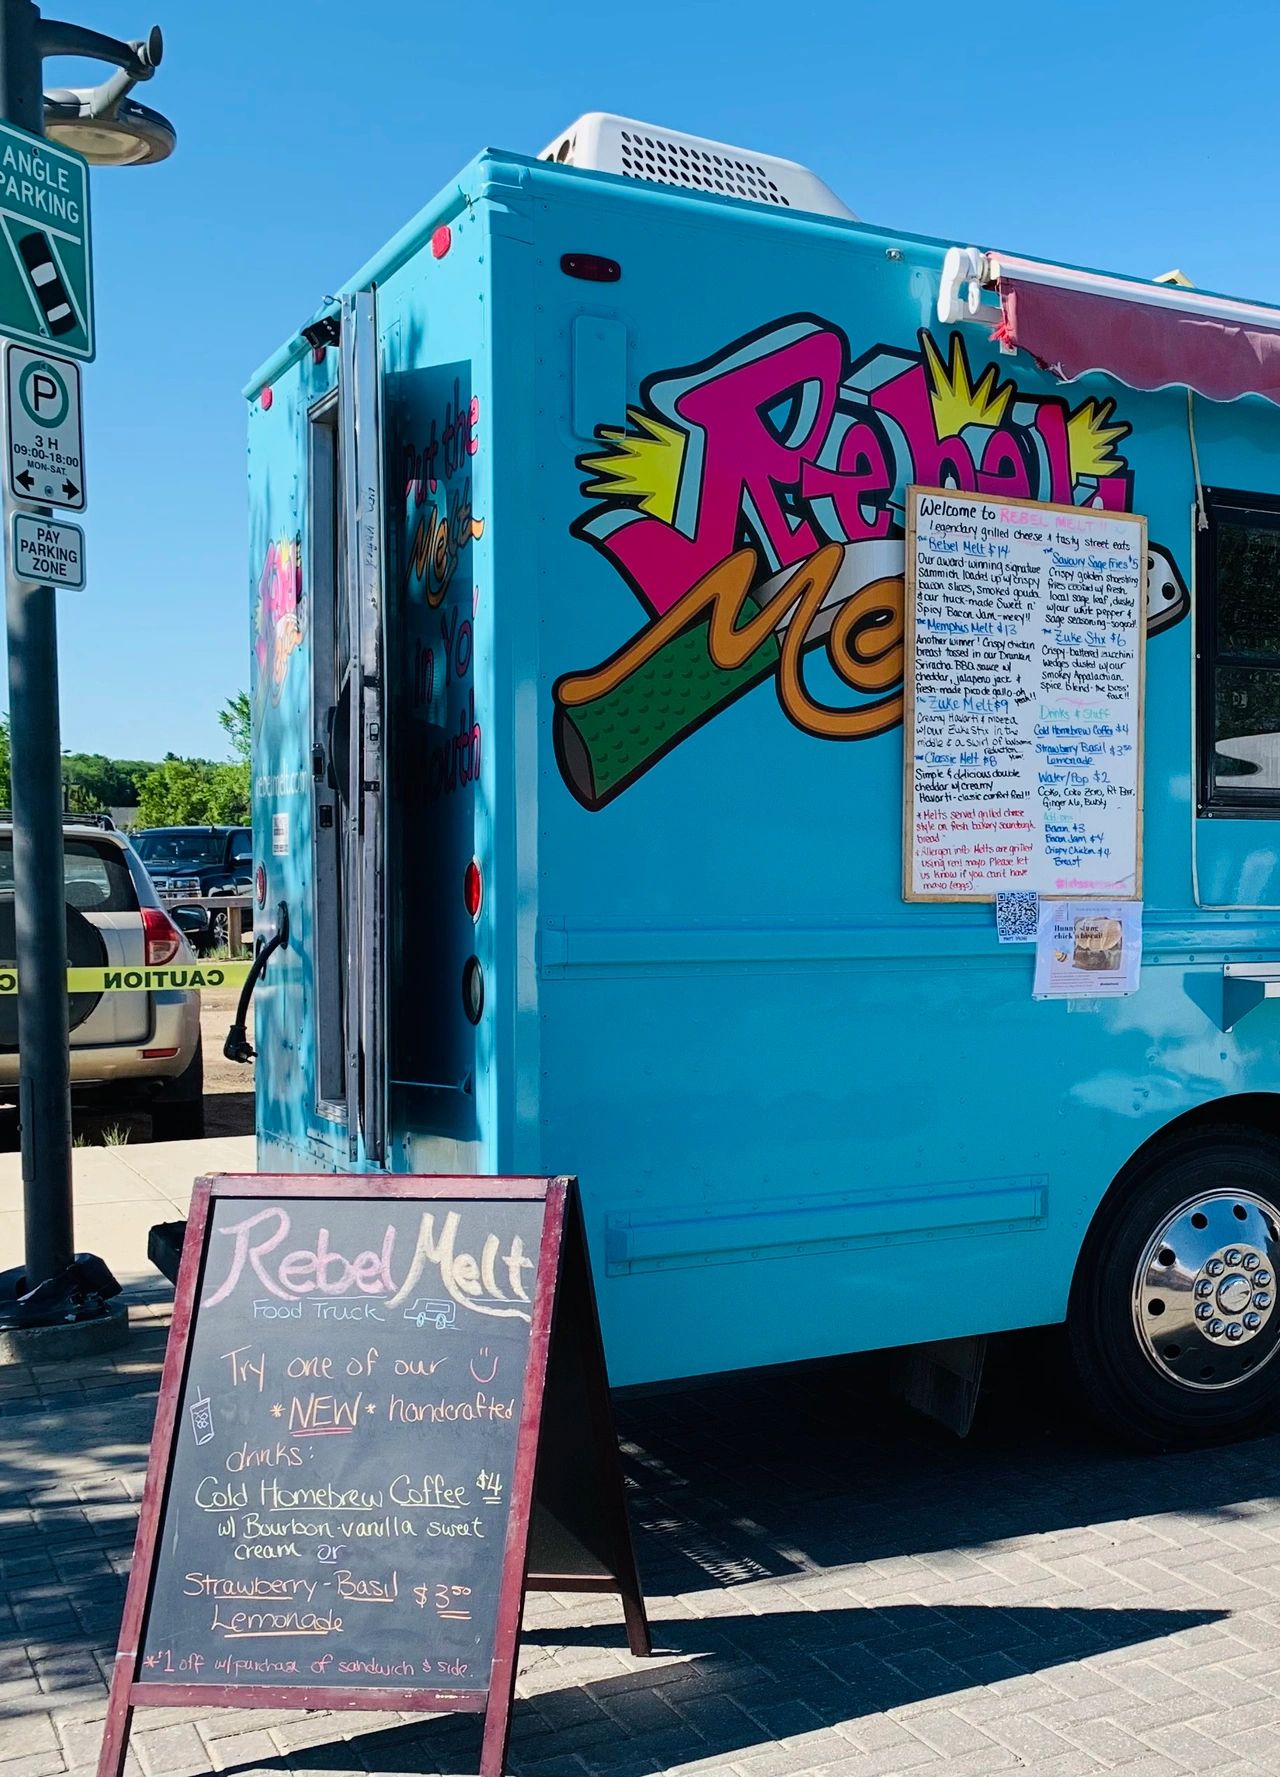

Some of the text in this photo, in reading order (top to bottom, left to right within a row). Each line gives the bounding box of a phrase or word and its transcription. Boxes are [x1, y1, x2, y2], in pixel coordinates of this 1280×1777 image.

[2, 145, 70, 193] ANGLE
[33, 374, 57, 412] P
[442, 376, 479, 479] the
[35, 435, 58, 450] 3 H
[14, 443, 79, 467] 09:00-18:00
[920, 498, 977, 518] Welcome
[982, 505, 996, 520] to
[37, 528, 60, 544] PAY
[405, 476, 485, 609] Melt
[981, 527, 1009, 542] grilled
[1056, 532, 1080, 551] tasty
[1085, 537, 1109, 549] street
[1113, 540, 1131, 551] eats
[20, 539, 78, 563] PARKING
[918, 552, 934, 564] Our
[928, 537, 1010, 559] Rebel Melt $14
[32, 557, 67, 576] ZONE
[917, 602, 975, 619] Spicy Bacon
[927, 619, 970, 634] Memphis
[970, 622, 994, 635] Melt
[972, 649, 981, 658] in
[963, 697, 993, 714] Melt
[1079, 742, 1107, 754] Basil
[1092, 769, 1111, 783] $2
[202, 1207, 534, 1322] Rebel Melt
[253, 1299, 386, 1322] Food Truck
[220, 1344, 448, 1393] Try one of our
[388, 1391, 516, 1424] handcrafted
[226, 1442, 315, 1472] drinks:
[195, 1469, 503, 1510] Cold Homebrew Coffee $4
[426, 1518, 486, 1538] sweet
[234, 1542, 348, 1563] cream or
[211, 1608, 345, 1634] Lemonade
[178, 1653, 205, 1671] off
[310, 1654, 334, 1673] of
[338, 1657, 415, 1677] sandwich
